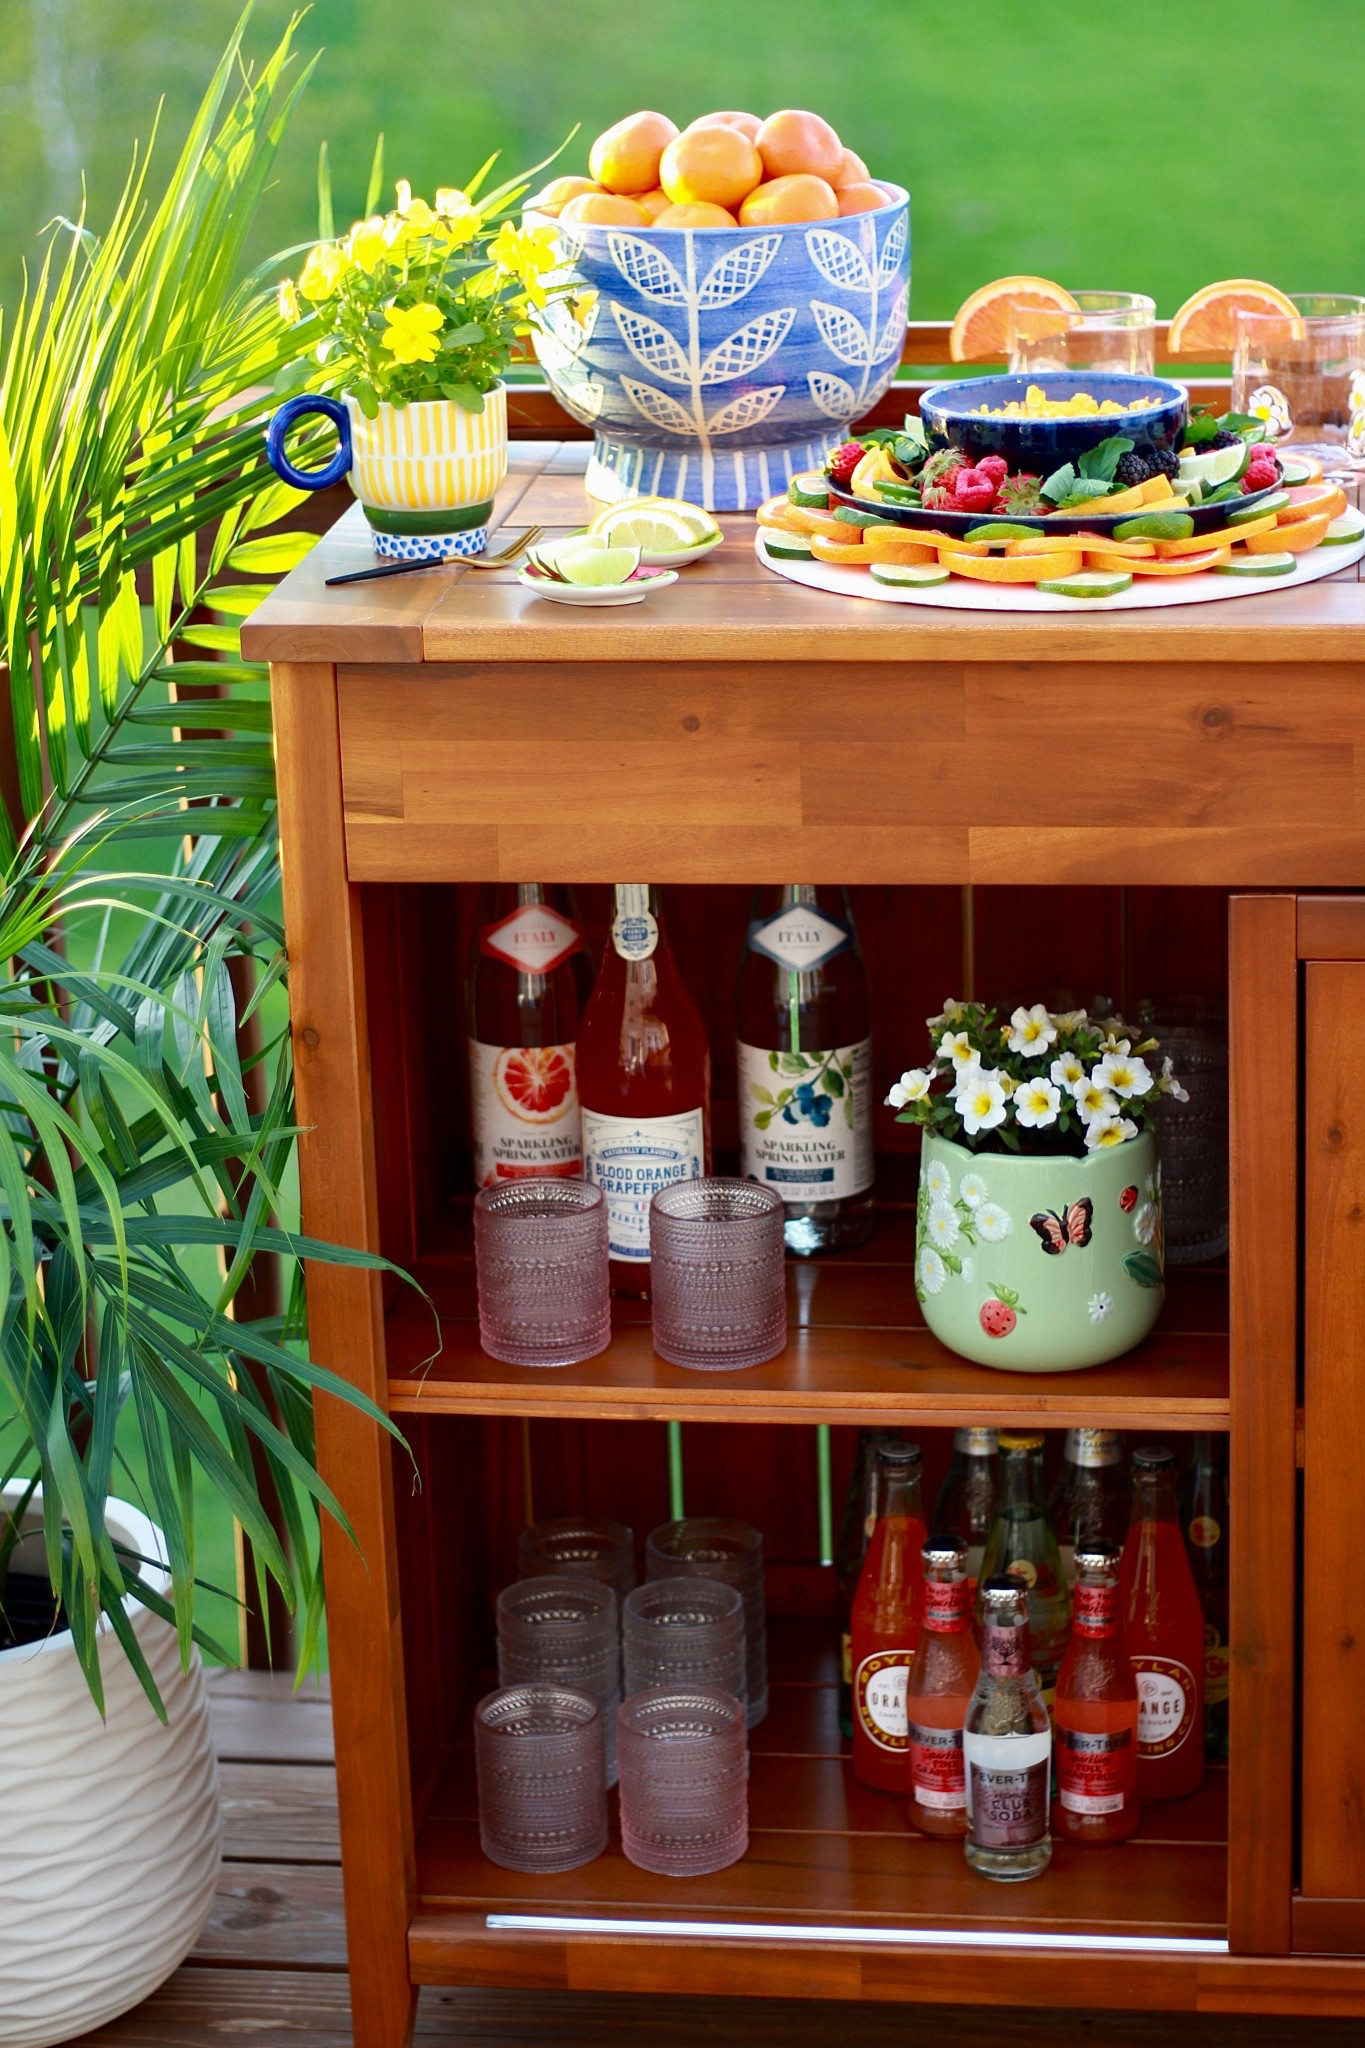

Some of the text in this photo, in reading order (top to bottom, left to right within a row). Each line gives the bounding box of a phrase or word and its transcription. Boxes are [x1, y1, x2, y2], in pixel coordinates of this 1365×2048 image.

[514, 930, 556, 944] ITALY
[778, 931, 822, 943] ITALY
[500, 1136, 573, 1149] SPARKLING
[763, 1139, 836, 1152] SPARKLING
[492, 1147, 537, 1160] SPRING
[603, 1147, 676, 1157] NATURALLY FLAVORED
[755, 1148, 846, 1163] SPRING WATER
[596, 1162, 634, 1180] BLOOD
[636, 1164, 687, 1181] ORANGE
[776, 1174, 823, 1183] FLAVORED
[611, 1210, 645, 1225] RENCH
[860, 1655, 912, 1683] BOYL
[1130, 1661, 1192, 1691] YLAN
[872, 1692, 901, 1708] ORA
[1140, 1699, 1181, 1715] ANGE
[861, 1706, 907, 1747] BOTTLI
[910, 1727, 963, 1747] FEVER-T
[991, 1798, 1031, 1811] CLUB
[990, 1809, 1032, 1821] SODA
